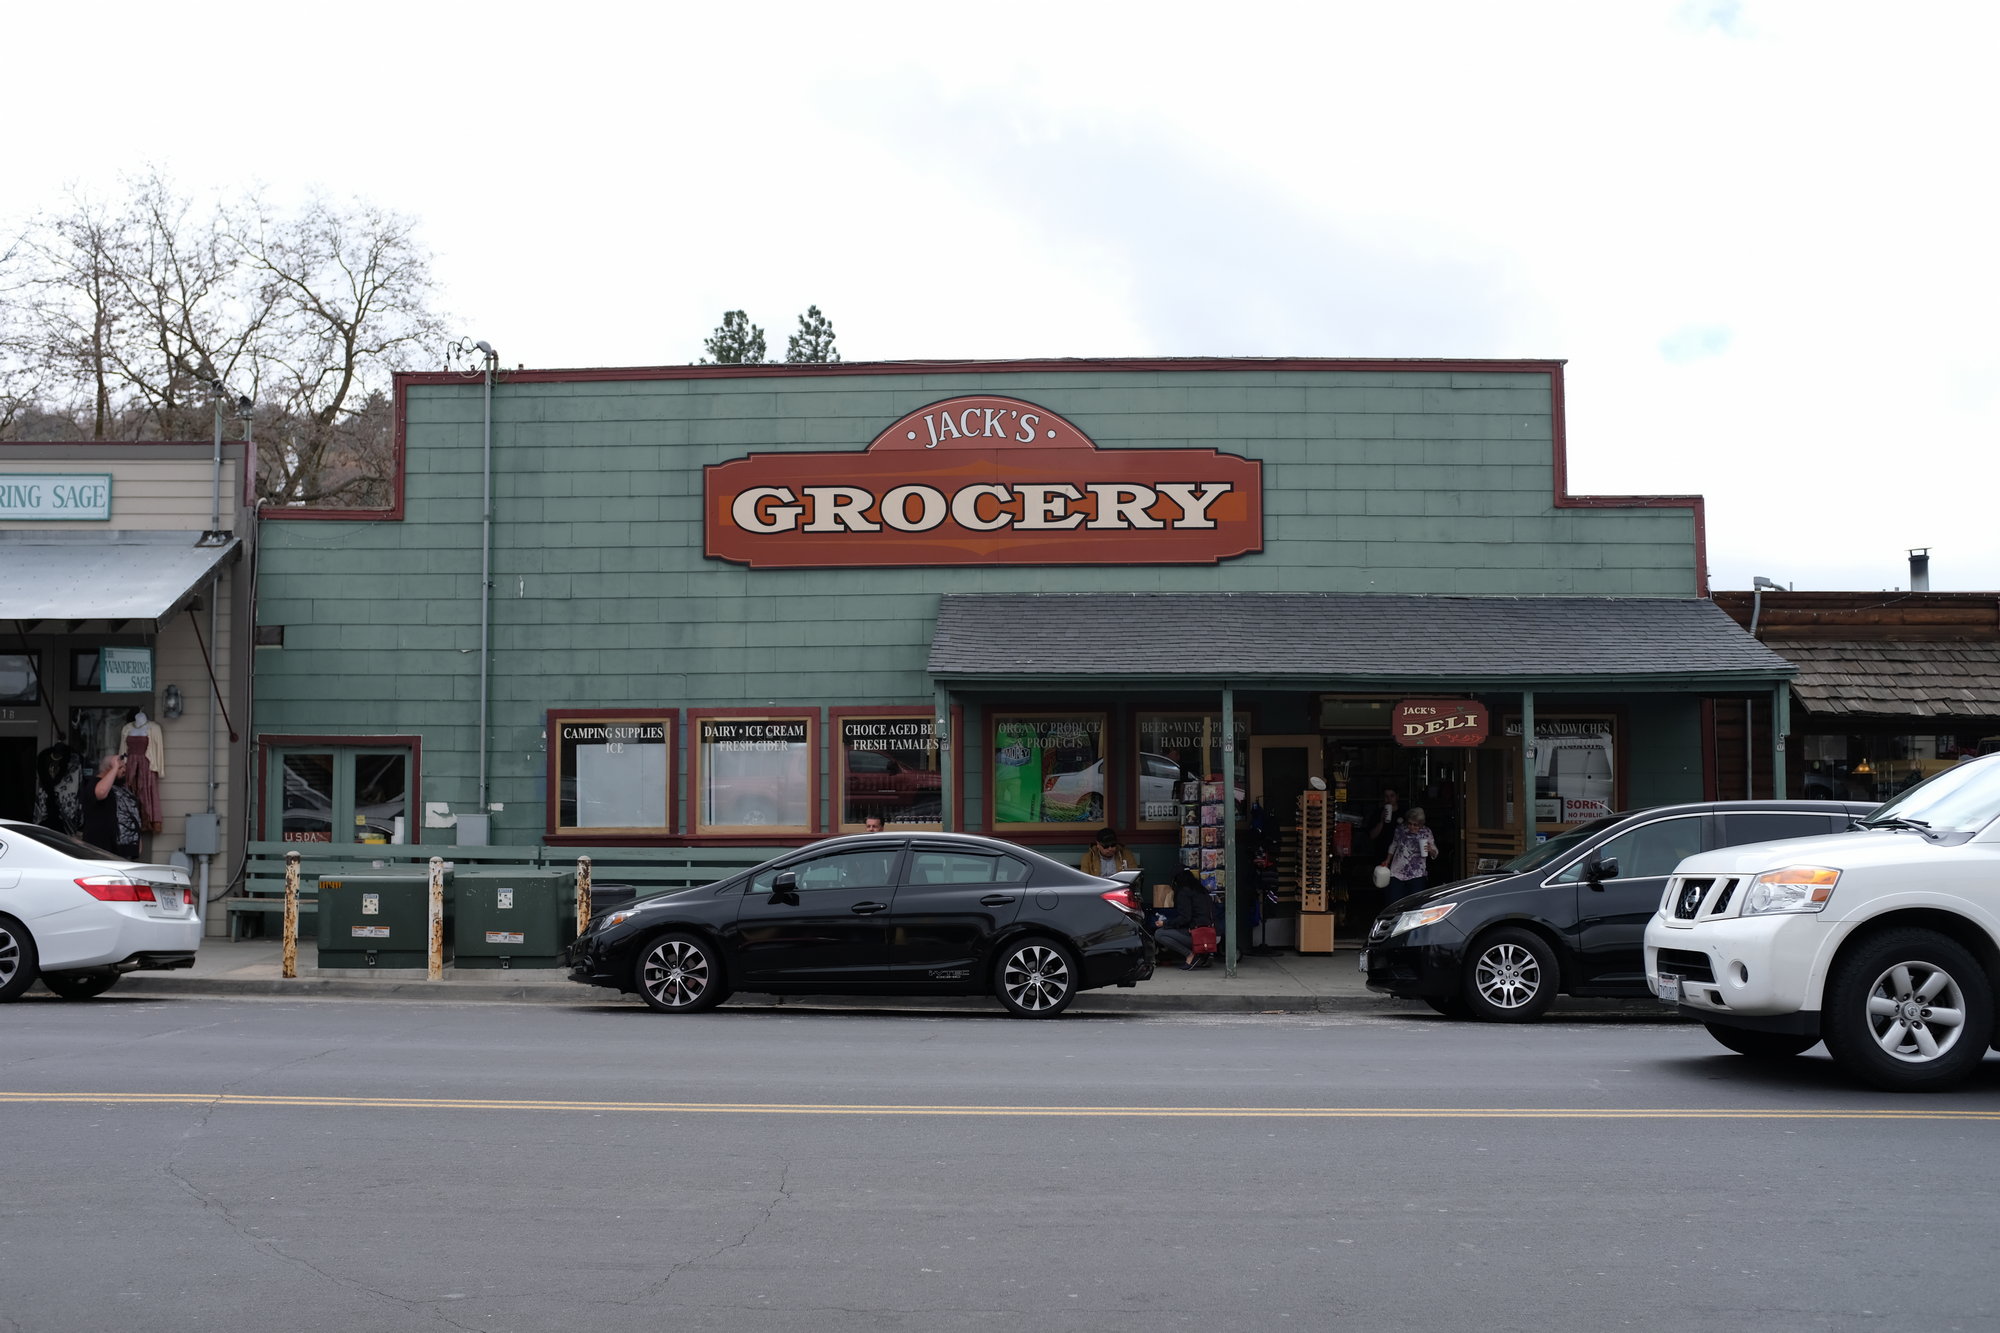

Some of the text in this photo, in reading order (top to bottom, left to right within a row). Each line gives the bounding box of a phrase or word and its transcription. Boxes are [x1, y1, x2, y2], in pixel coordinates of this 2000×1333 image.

[923, 407, 1041, 449] JACK'S
[52, 485, 106, 508] SAGE
[731, 482, 1234, 534] GROCERY
[105, 660, 150, 674] WANDERING
[131, 676, 150, 689] SAGE
[1403, 706, 1437, 716] JACK'S
[704, 725, 804, 737] DAIRY ICE CREAM
[845, 724, 887, 736] CHOICE
[888, 724, 918, 736] AGED
[998, 722, 1101, 733] ORGANIC PRODUCE
[1403, 715, 1478, 736] DELI
[1540, 722, 1610, 734] SANDWICHES
[563, 726, 664, 739] CAMPING SUPPLIES
[606, 742, 624, 754] ICE
[720, 740, 788, 752] FRESH CIDER
[853, 739, 939, 751] FRESH TAMALES
[1027, 738, 1083, 749] PRODUCTS
[1161, 737, 1191, 748] HARD
[1566, 799, 1605, 810] SORRY
[1147, 805, 1179, 817] CLOSED
